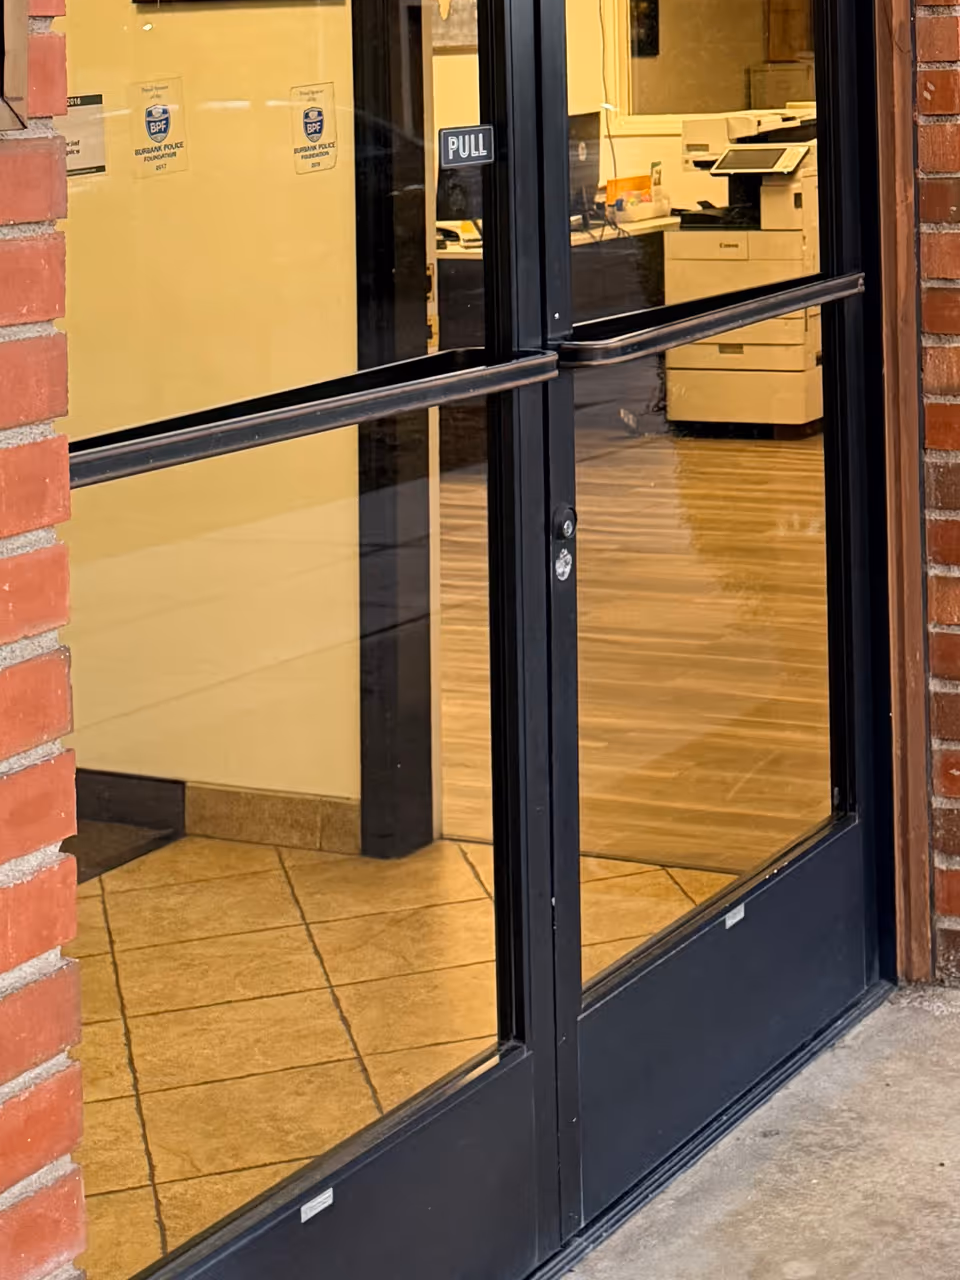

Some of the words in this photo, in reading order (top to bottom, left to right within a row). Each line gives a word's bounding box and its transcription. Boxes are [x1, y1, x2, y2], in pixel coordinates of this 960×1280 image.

[149, 121, 167, 134] BPF
[306, 122, 321, 134] BPF
[134, 145, 162, 156] BURBANK
[163, 141, 184, 151] POLICE
[293, 145, 317, 154] BURBANK
[318, 141, 336, 150] POLICE
[448, 133, 487, 160] PULL
